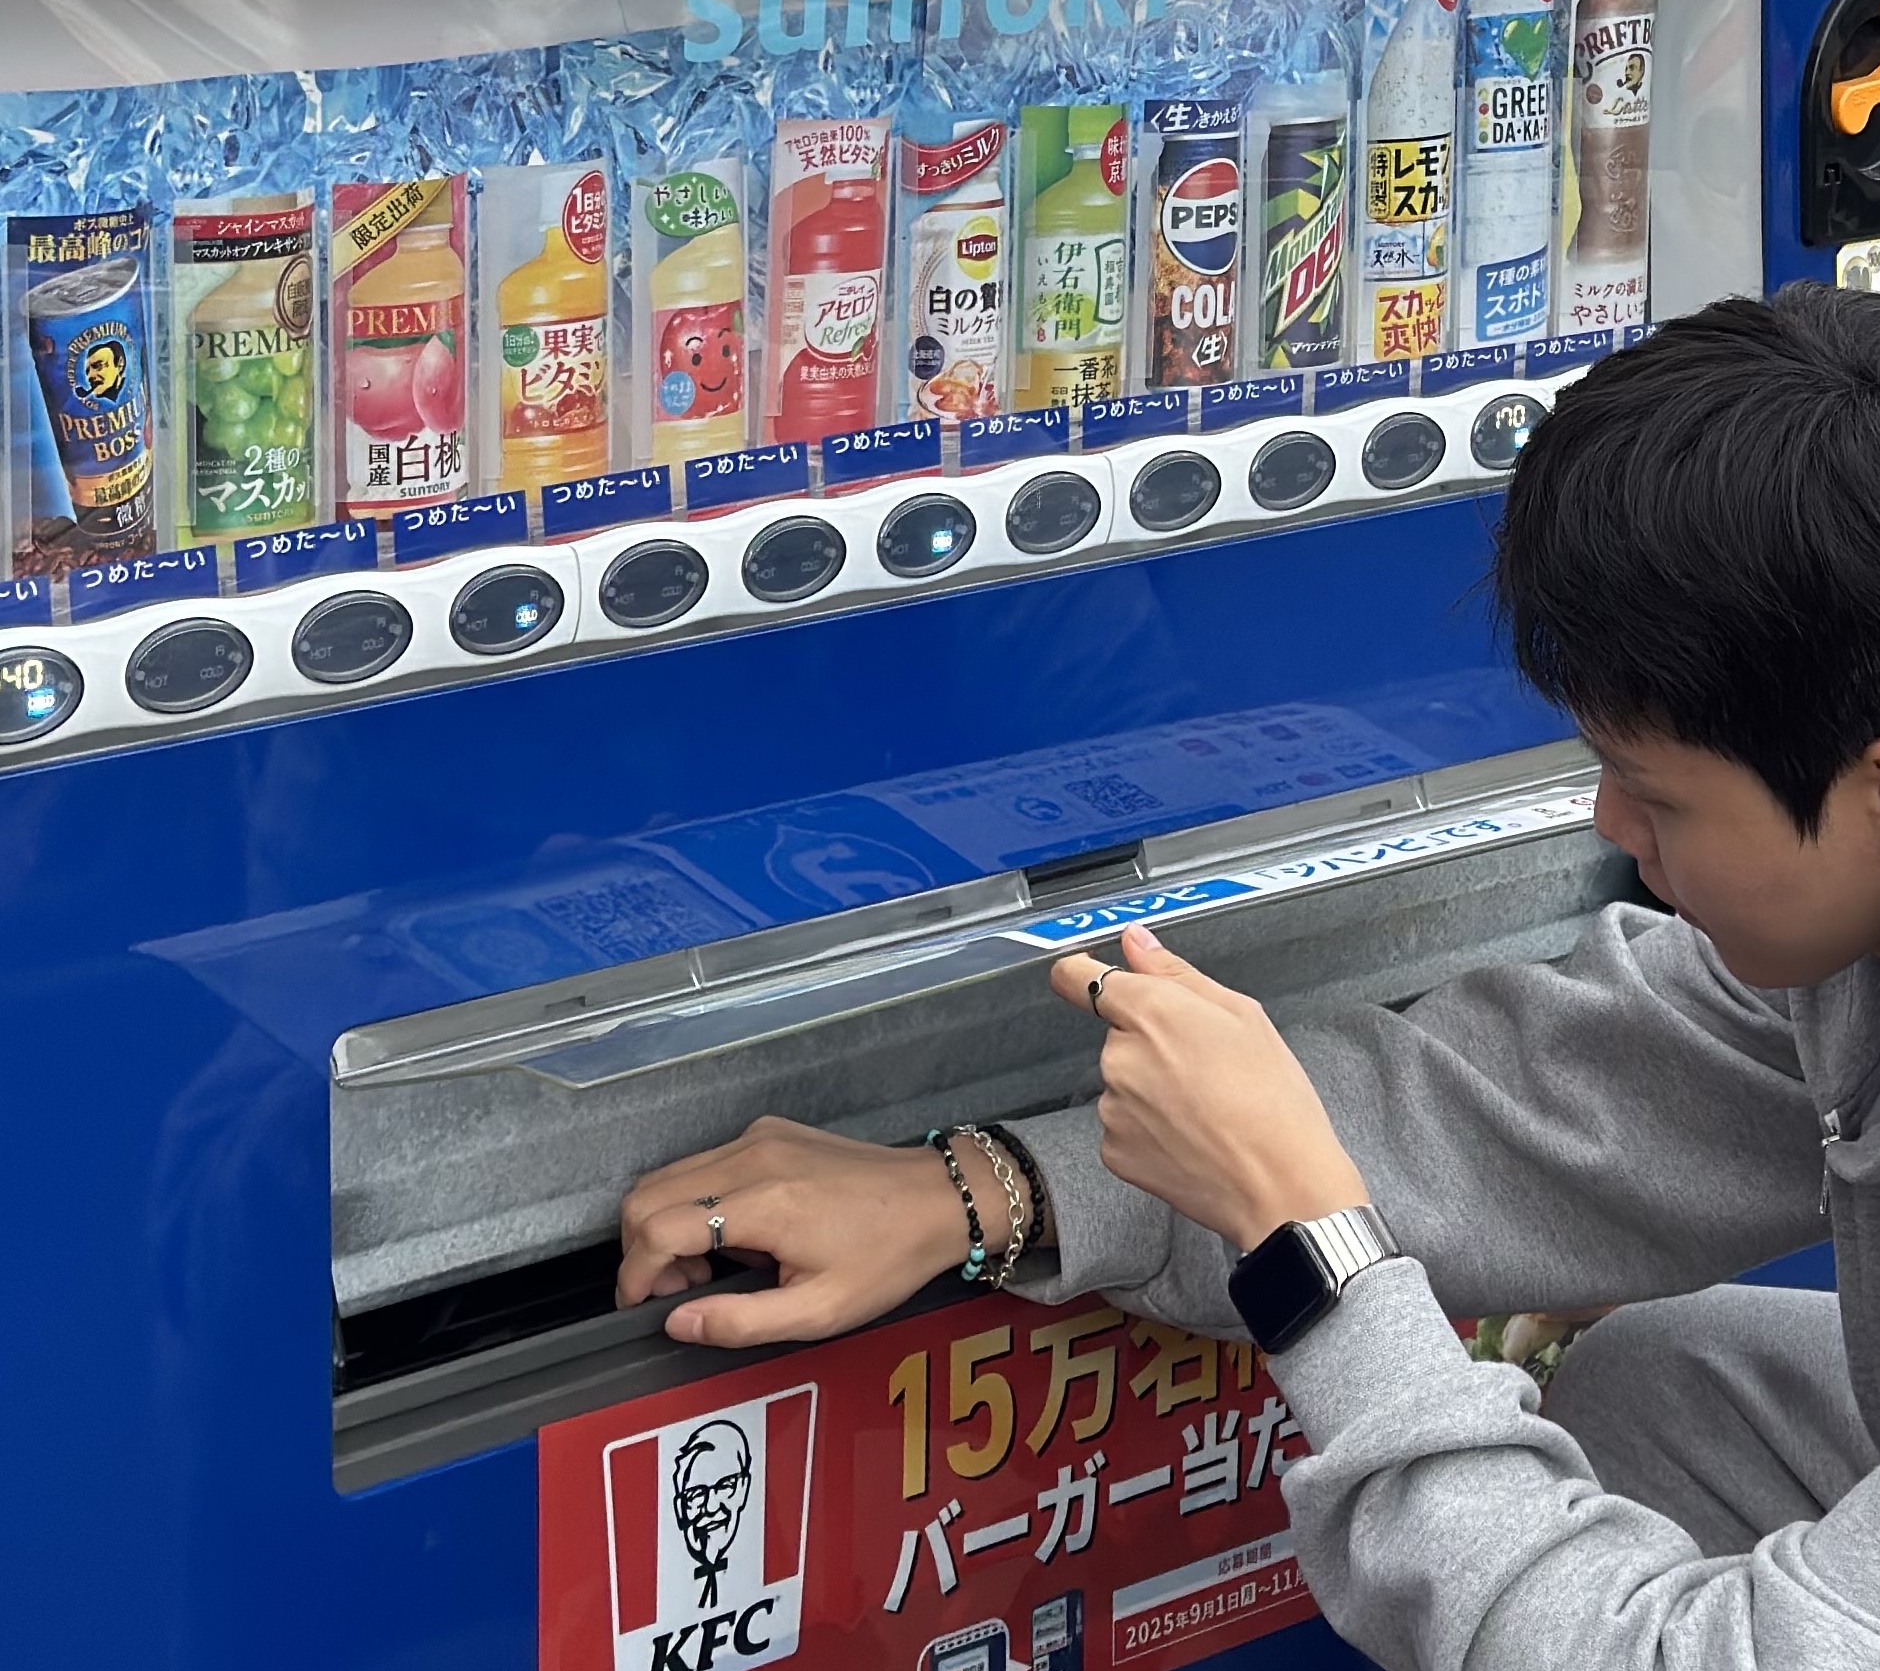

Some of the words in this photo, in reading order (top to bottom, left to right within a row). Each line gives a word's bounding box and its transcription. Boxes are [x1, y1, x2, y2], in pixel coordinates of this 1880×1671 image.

[653, 185, 730, 206] やさしい
[1371, 152, 1389, 208] 特製
[351, 181, 424, 249] 限定出荷
[682, 207, 733, 227] 味わい
[962, 240, 996, 258] Lipton
[1373, 250, 1414, 269] 天然水
[815, 289, 875, 326] アセロラ
[1053, 241, 1086, 342] 伊右衛門
[1054, 356, 1117, 381] 一番茶
[244, 445, 300, 475] 2種の
[366, 443, 390, 487] 国産
[395, 430, 461, 485] 白桃
[400, 481, 450, 497] SUNTORY
[0, 660, 44, 688] 40
[1057, 884, 1209, 930] ジハンピ
[1218, 1542, 1272, 1576] 応募期間
